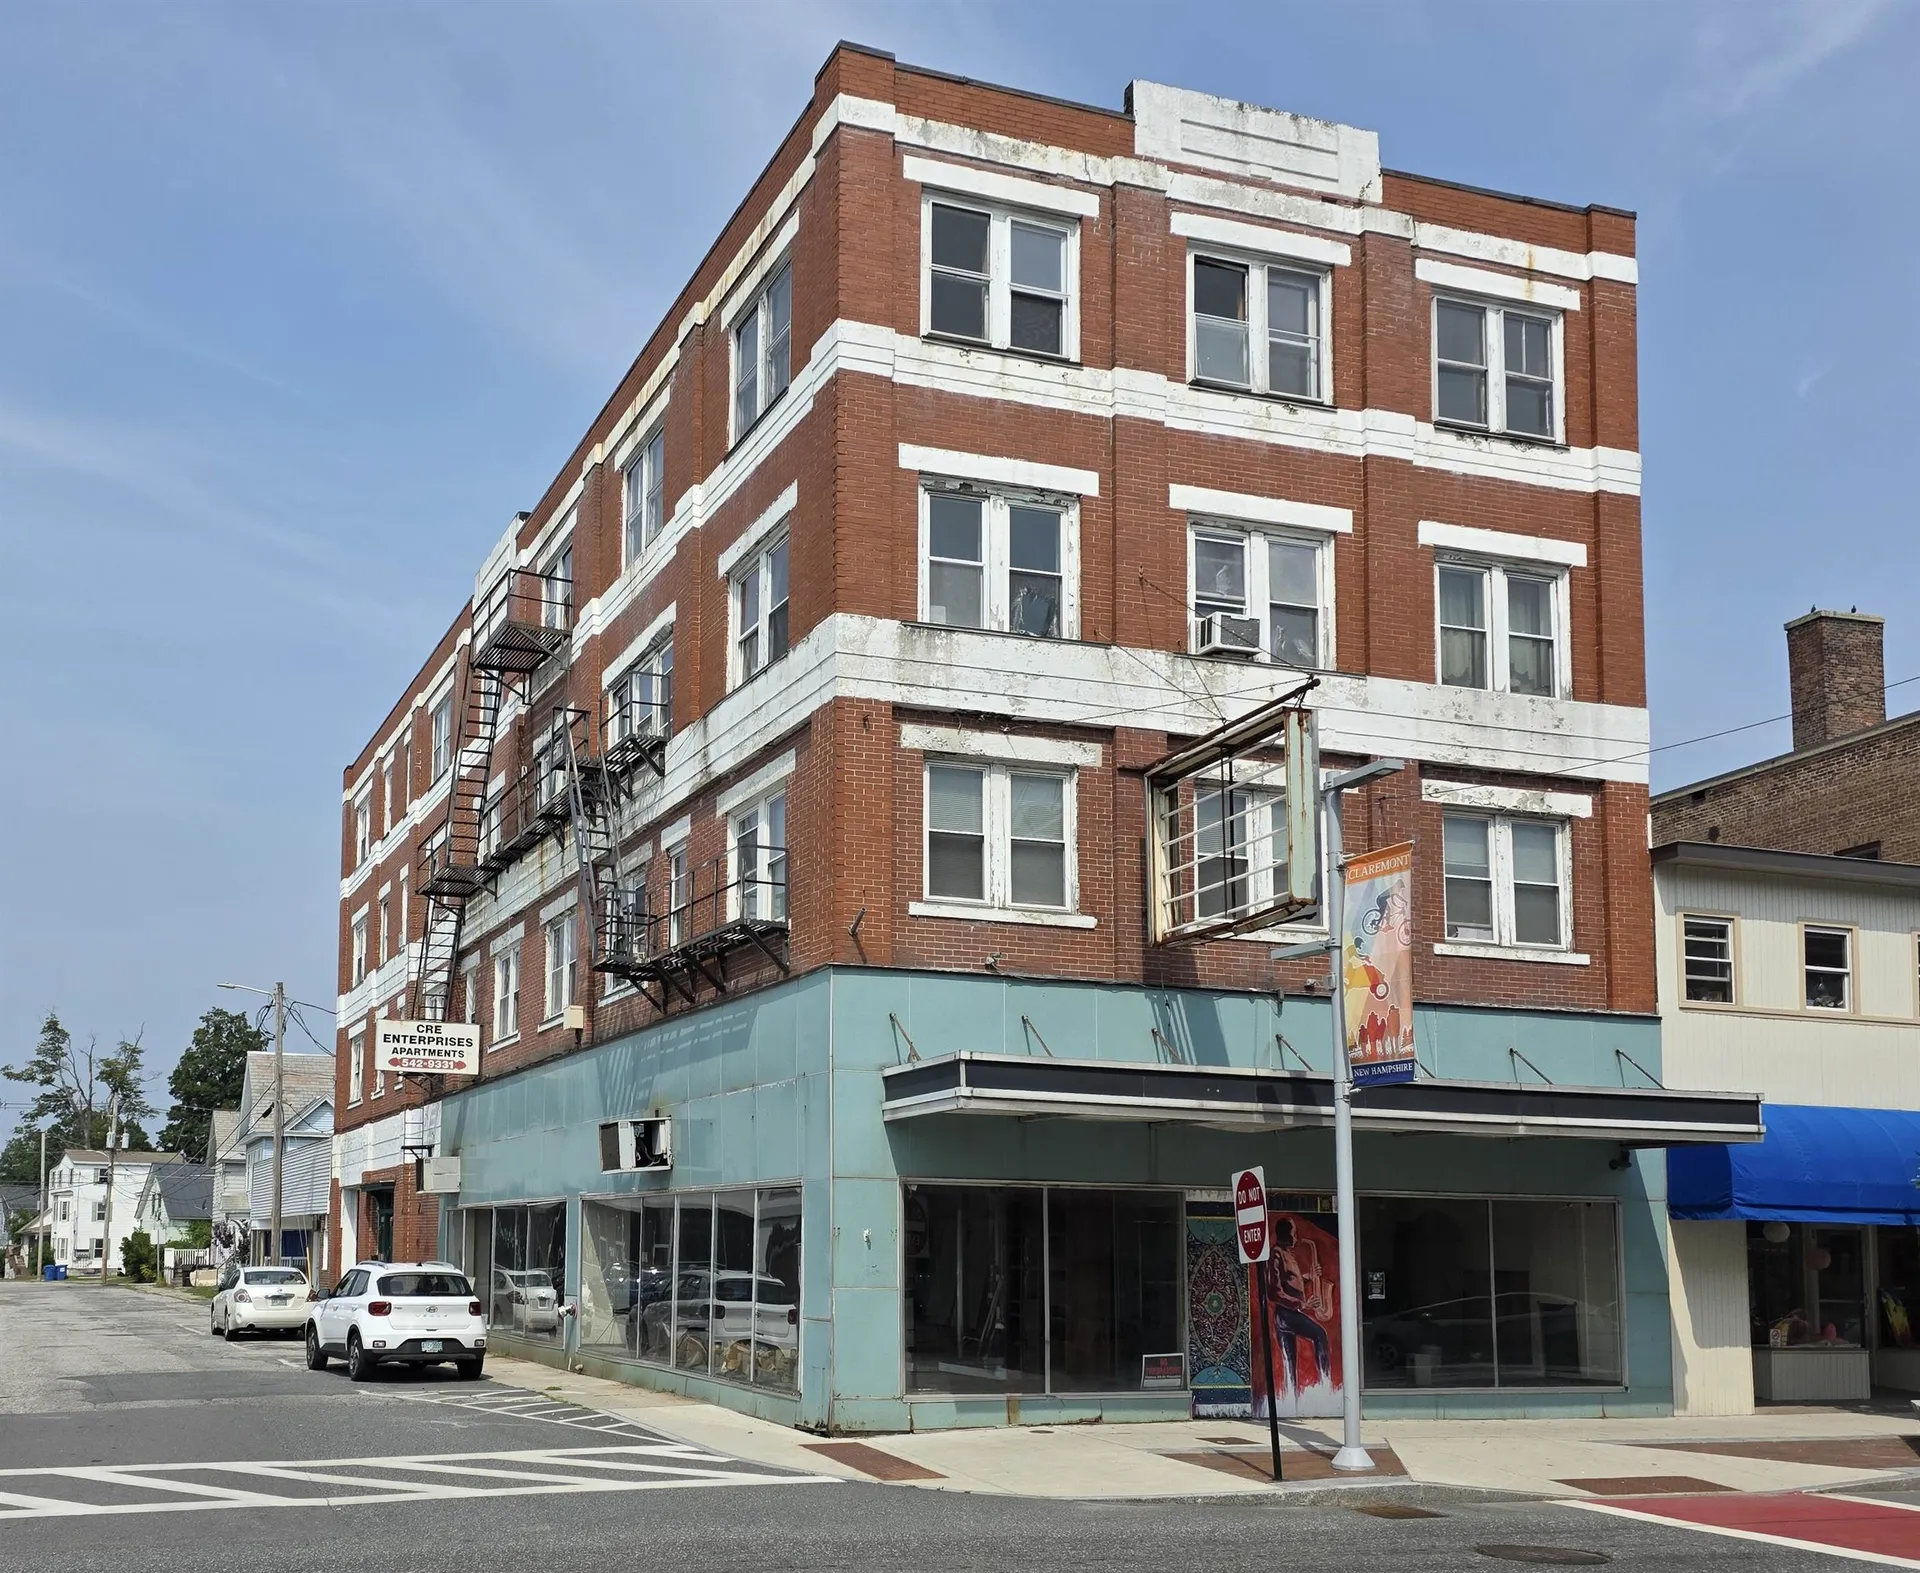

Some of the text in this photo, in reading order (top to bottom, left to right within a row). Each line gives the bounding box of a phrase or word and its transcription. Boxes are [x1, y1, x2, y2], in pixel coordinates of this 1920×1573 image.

[1348, 853, 1410, 880] CLAREMONT
[416, 1024, 442, 1034] CRE
[383, 1033, 473, 1047] ENTERPRISES
[391, 1047, 465, 1058] APARTMENTS
[401, 1058, 454, 1069] 542-9331
[1354, 1062, 1413, 1078] NEW HAMPSHIRE
[1238, 1186, 1260, 1205] DO NOT
[1243, 1227, 1262, 1244] ENTER
